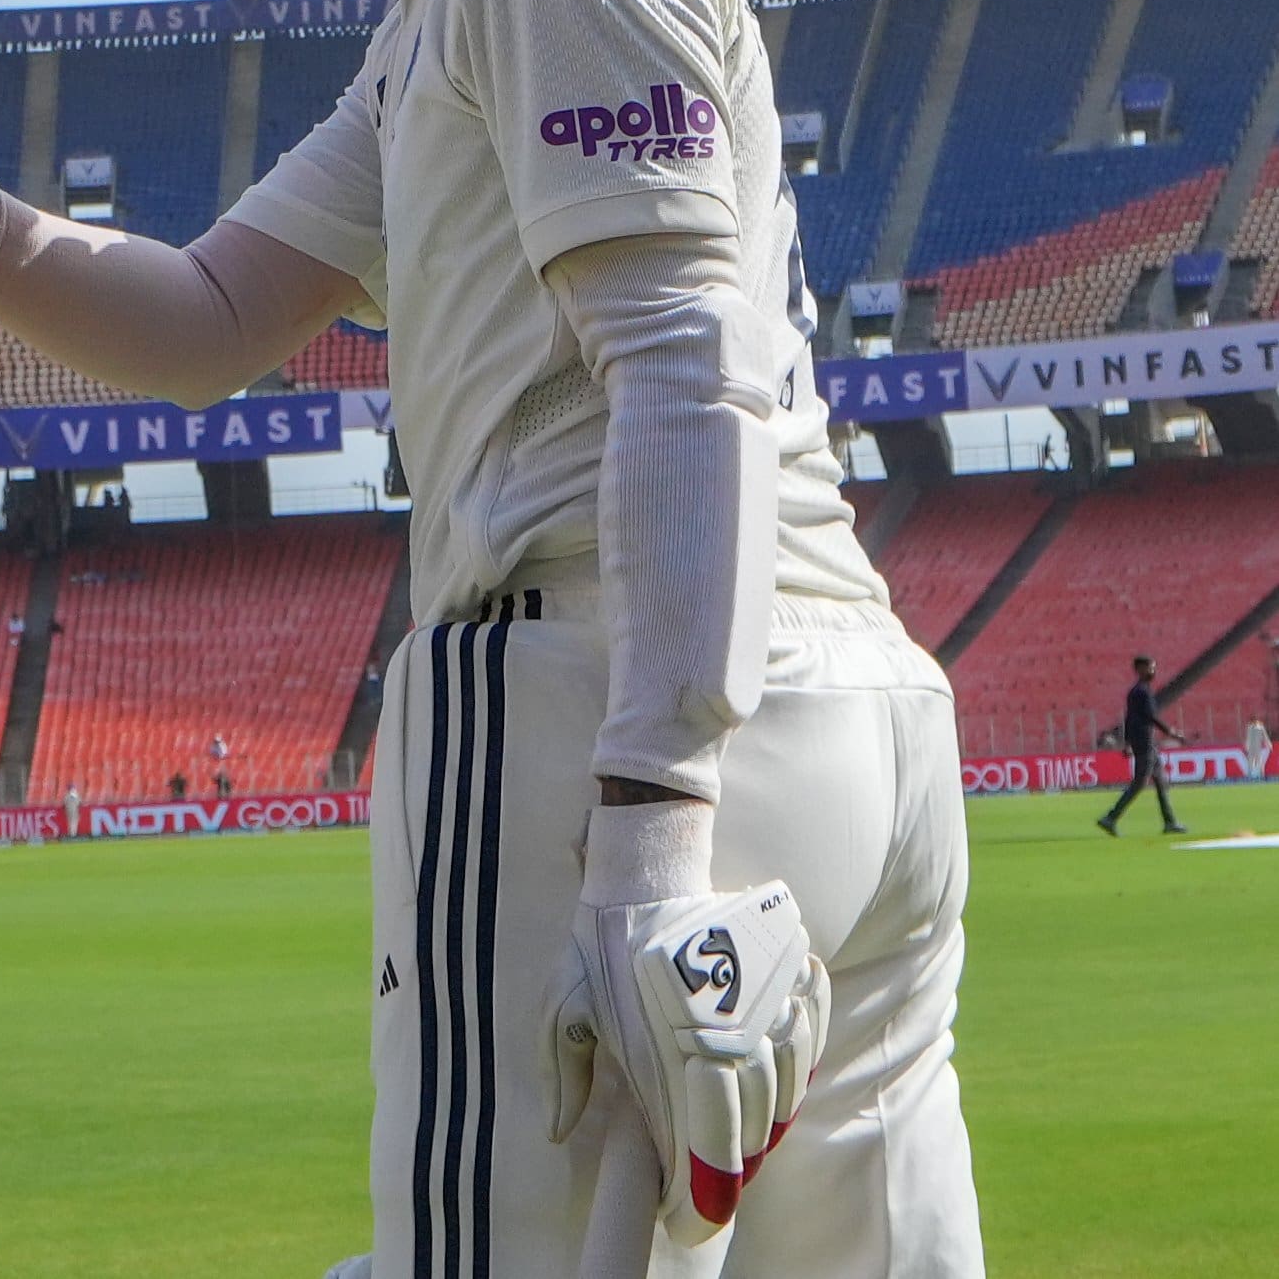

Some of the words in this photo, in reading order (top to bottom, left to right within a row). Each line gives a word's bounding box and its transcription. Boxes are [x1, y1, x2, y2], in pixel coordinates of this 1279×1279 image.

[21, 5, 211, 37] VINFAST
[540, 83, 716, 157] apollo
[607, 137, 715, 162] TYRES
[1033, 341, 1279, 392] VINFAST
[61, 408, 331, 454] VINFAST
[1036, 753, 1099, 789] TIMES
[91, 803, 228, 838] NDTV
[238, 795, 340, 830] GOOD
